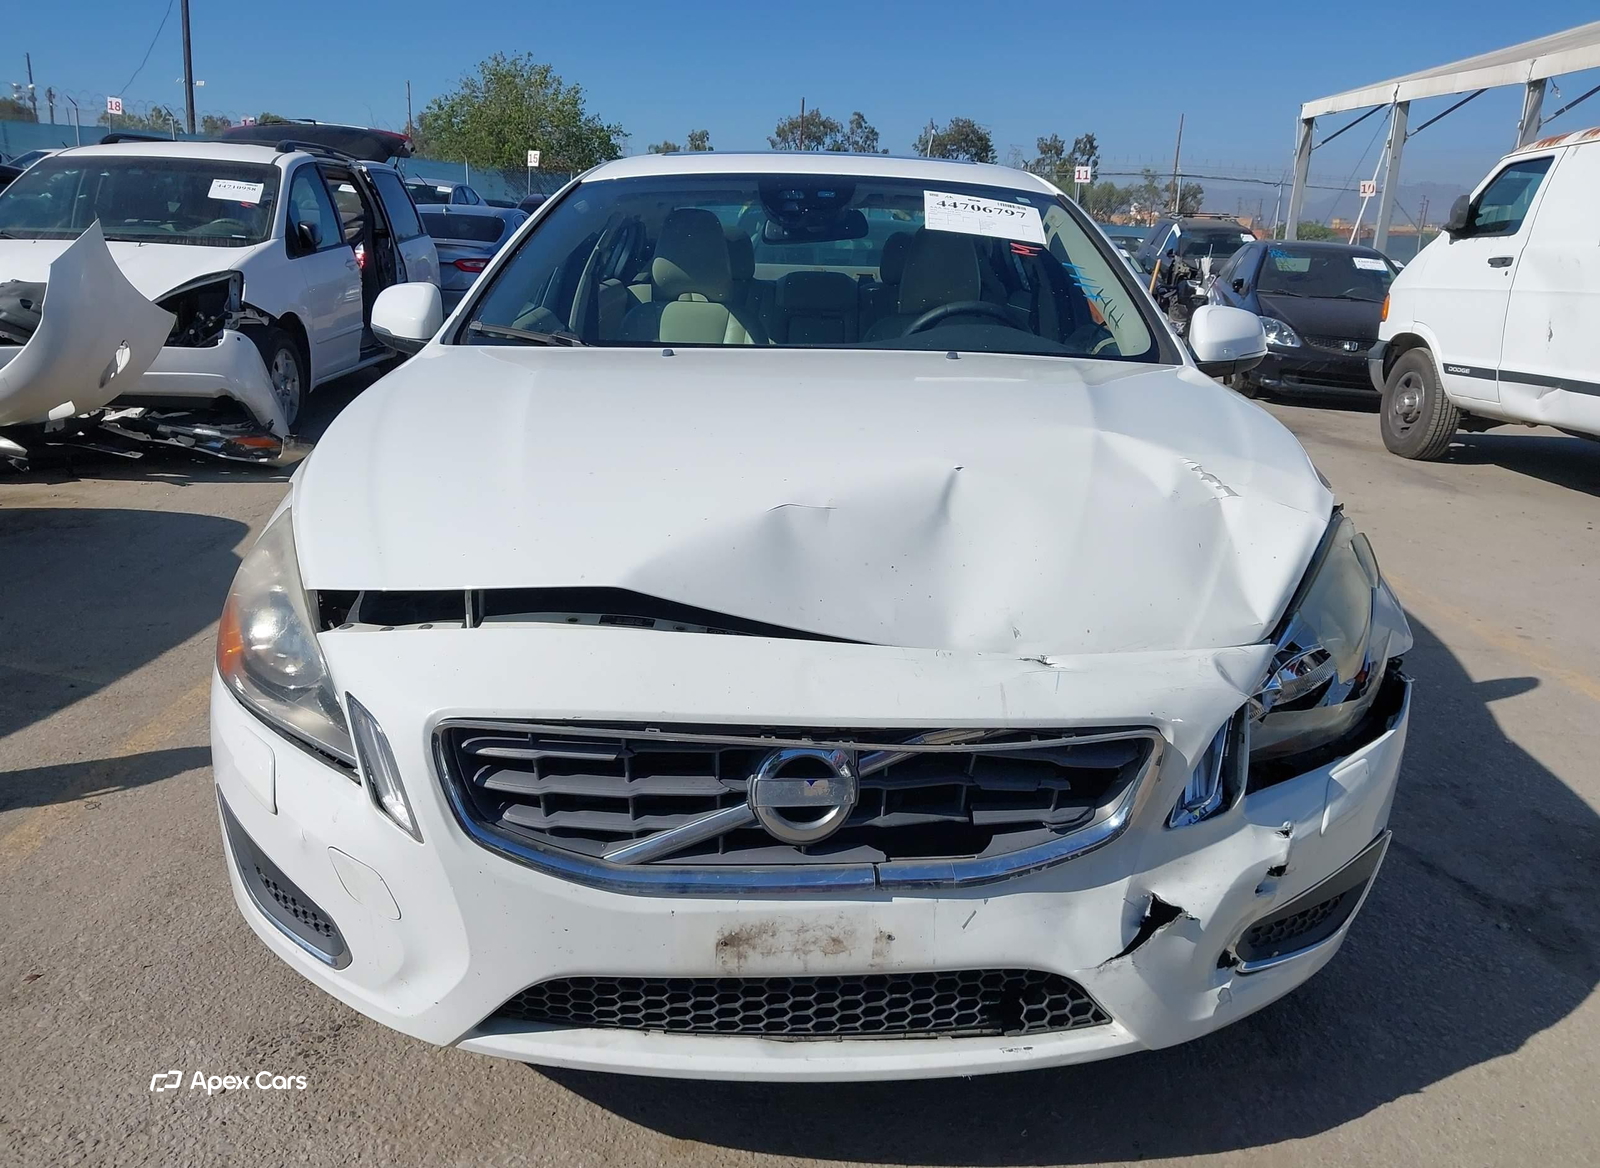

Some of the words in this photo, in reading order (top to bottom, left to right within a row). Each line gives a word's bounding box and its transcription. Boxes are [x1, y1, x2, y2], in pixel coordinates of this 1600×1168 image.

[108, 100, 121, 111] 18
[528, 153, 538, 164] 15
[1075, 169, 1090, 180] 11
[936, 200, 1026, 218] 44706797
[1447, 365, 1471, 374] DODGE
